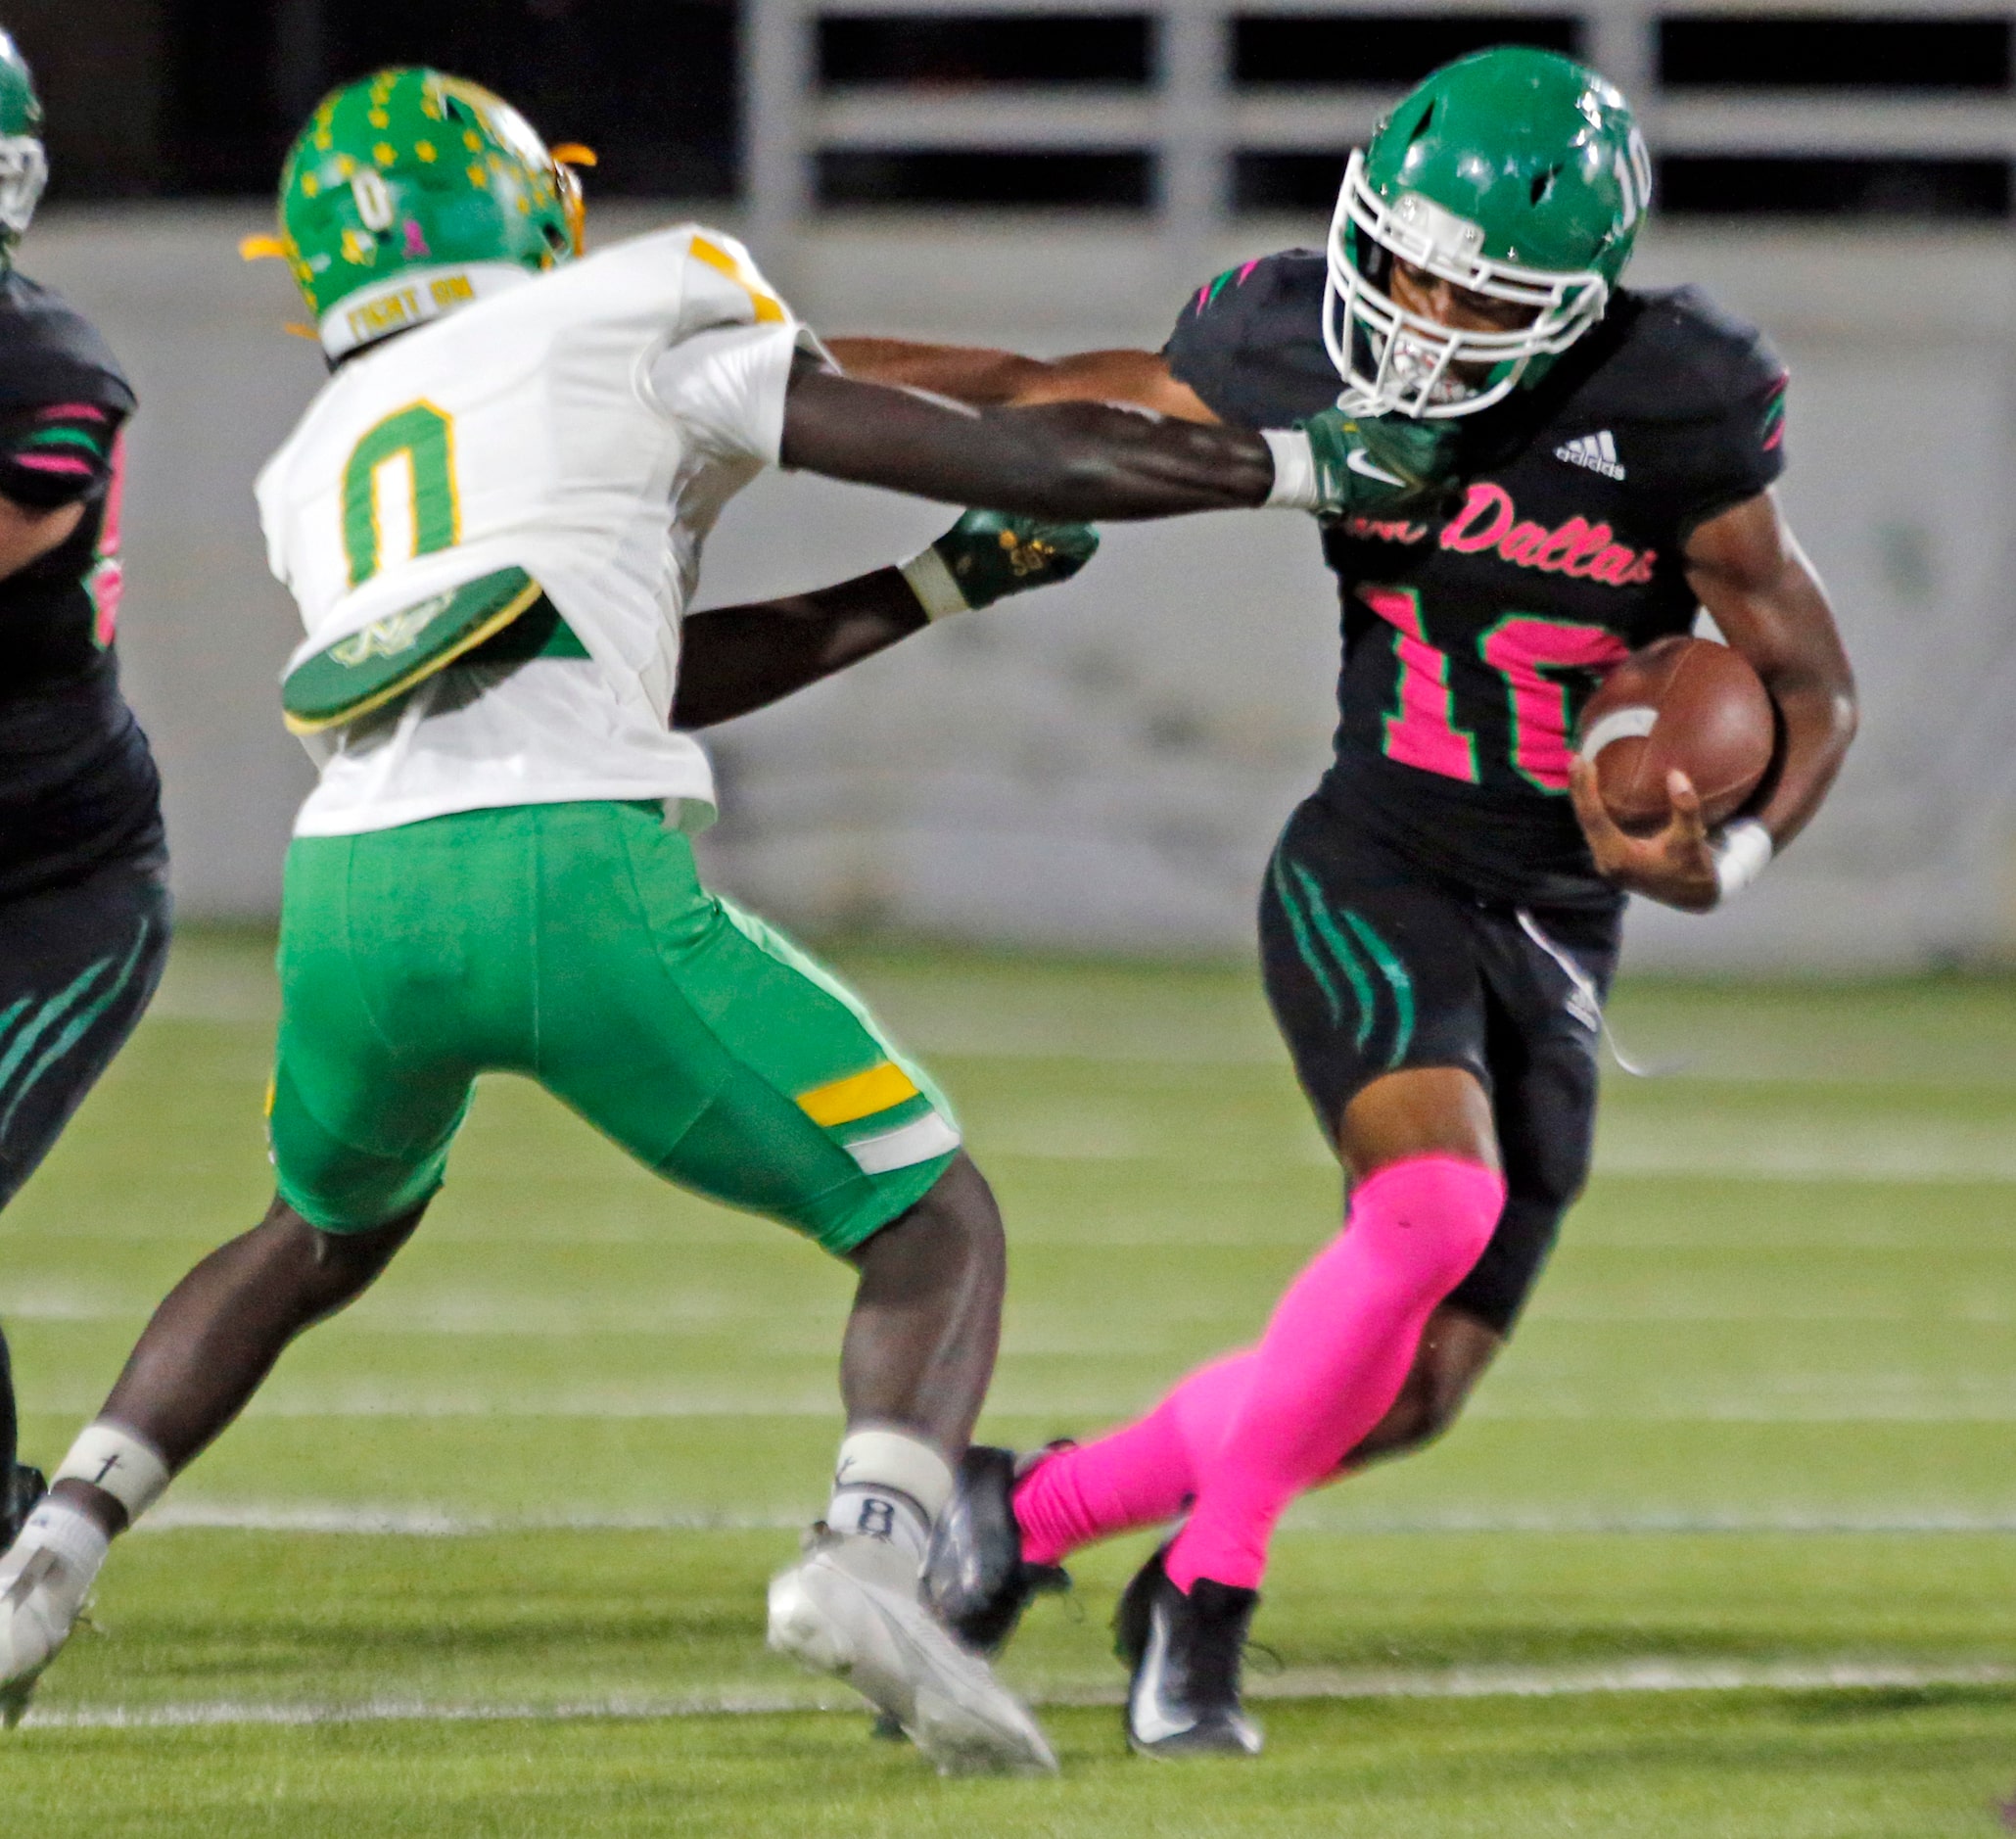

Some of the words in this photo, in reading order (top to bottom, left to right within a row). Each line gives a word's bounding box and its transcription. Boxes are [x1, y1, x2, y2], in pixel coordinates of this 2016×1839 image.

[352, 170, 393, 231] 0
[340, 398, 461, 589] 0
[1555, 447, 1625, 481] adidas
[1440, 482, 1657, 587] Dallas
